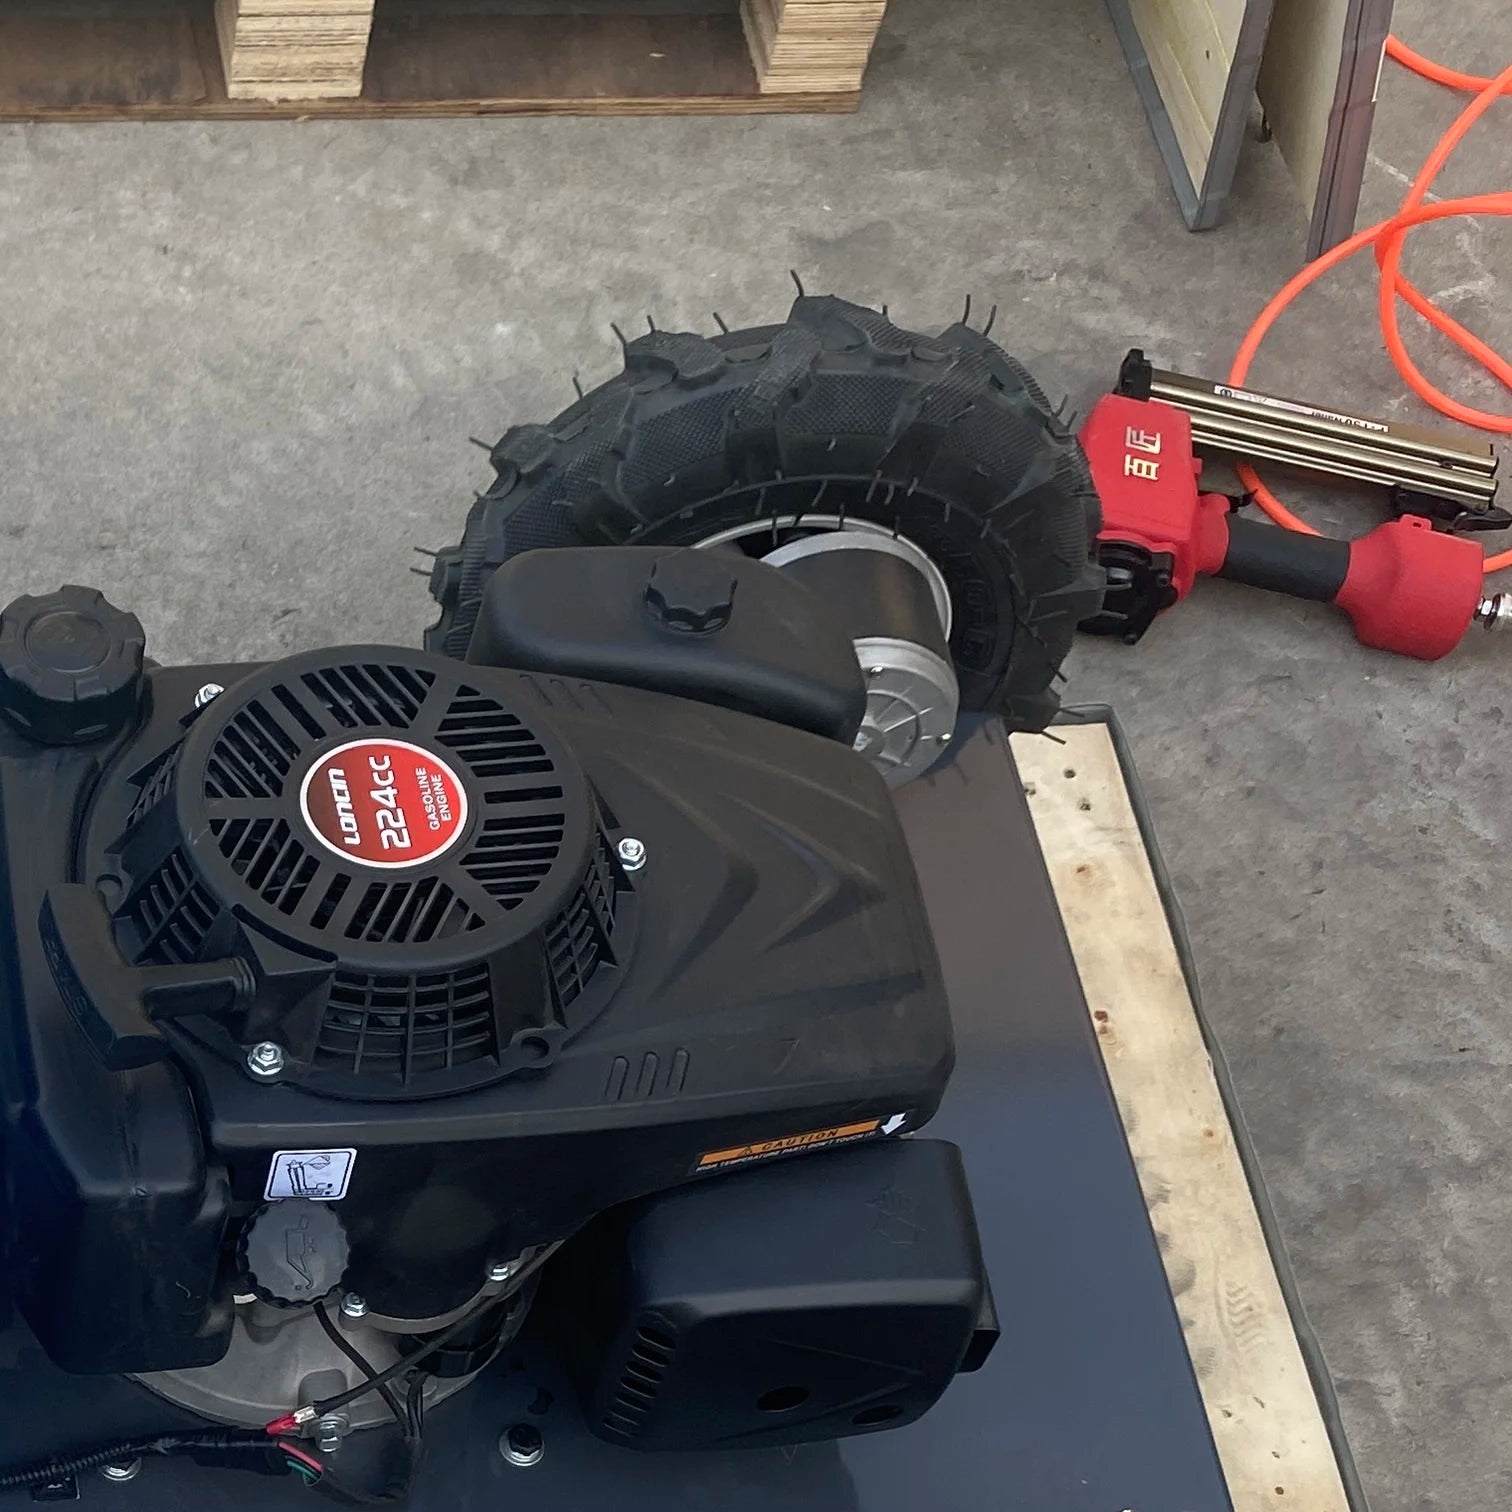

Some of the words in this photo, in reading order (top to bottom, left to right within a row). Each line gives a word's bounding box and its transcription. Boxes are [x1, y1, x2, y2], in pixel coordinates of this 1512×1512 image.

[1124, 425, 1161, 481] 百匠
[327, 768, 361, 845] LONCIN
[368, 755, 412, 850] 224cc
[415, 767, 441, 830] GASOLINE
[431, 774, 452, 822] ENGINE
[762, 1129, 839, 1150] CAUTION
